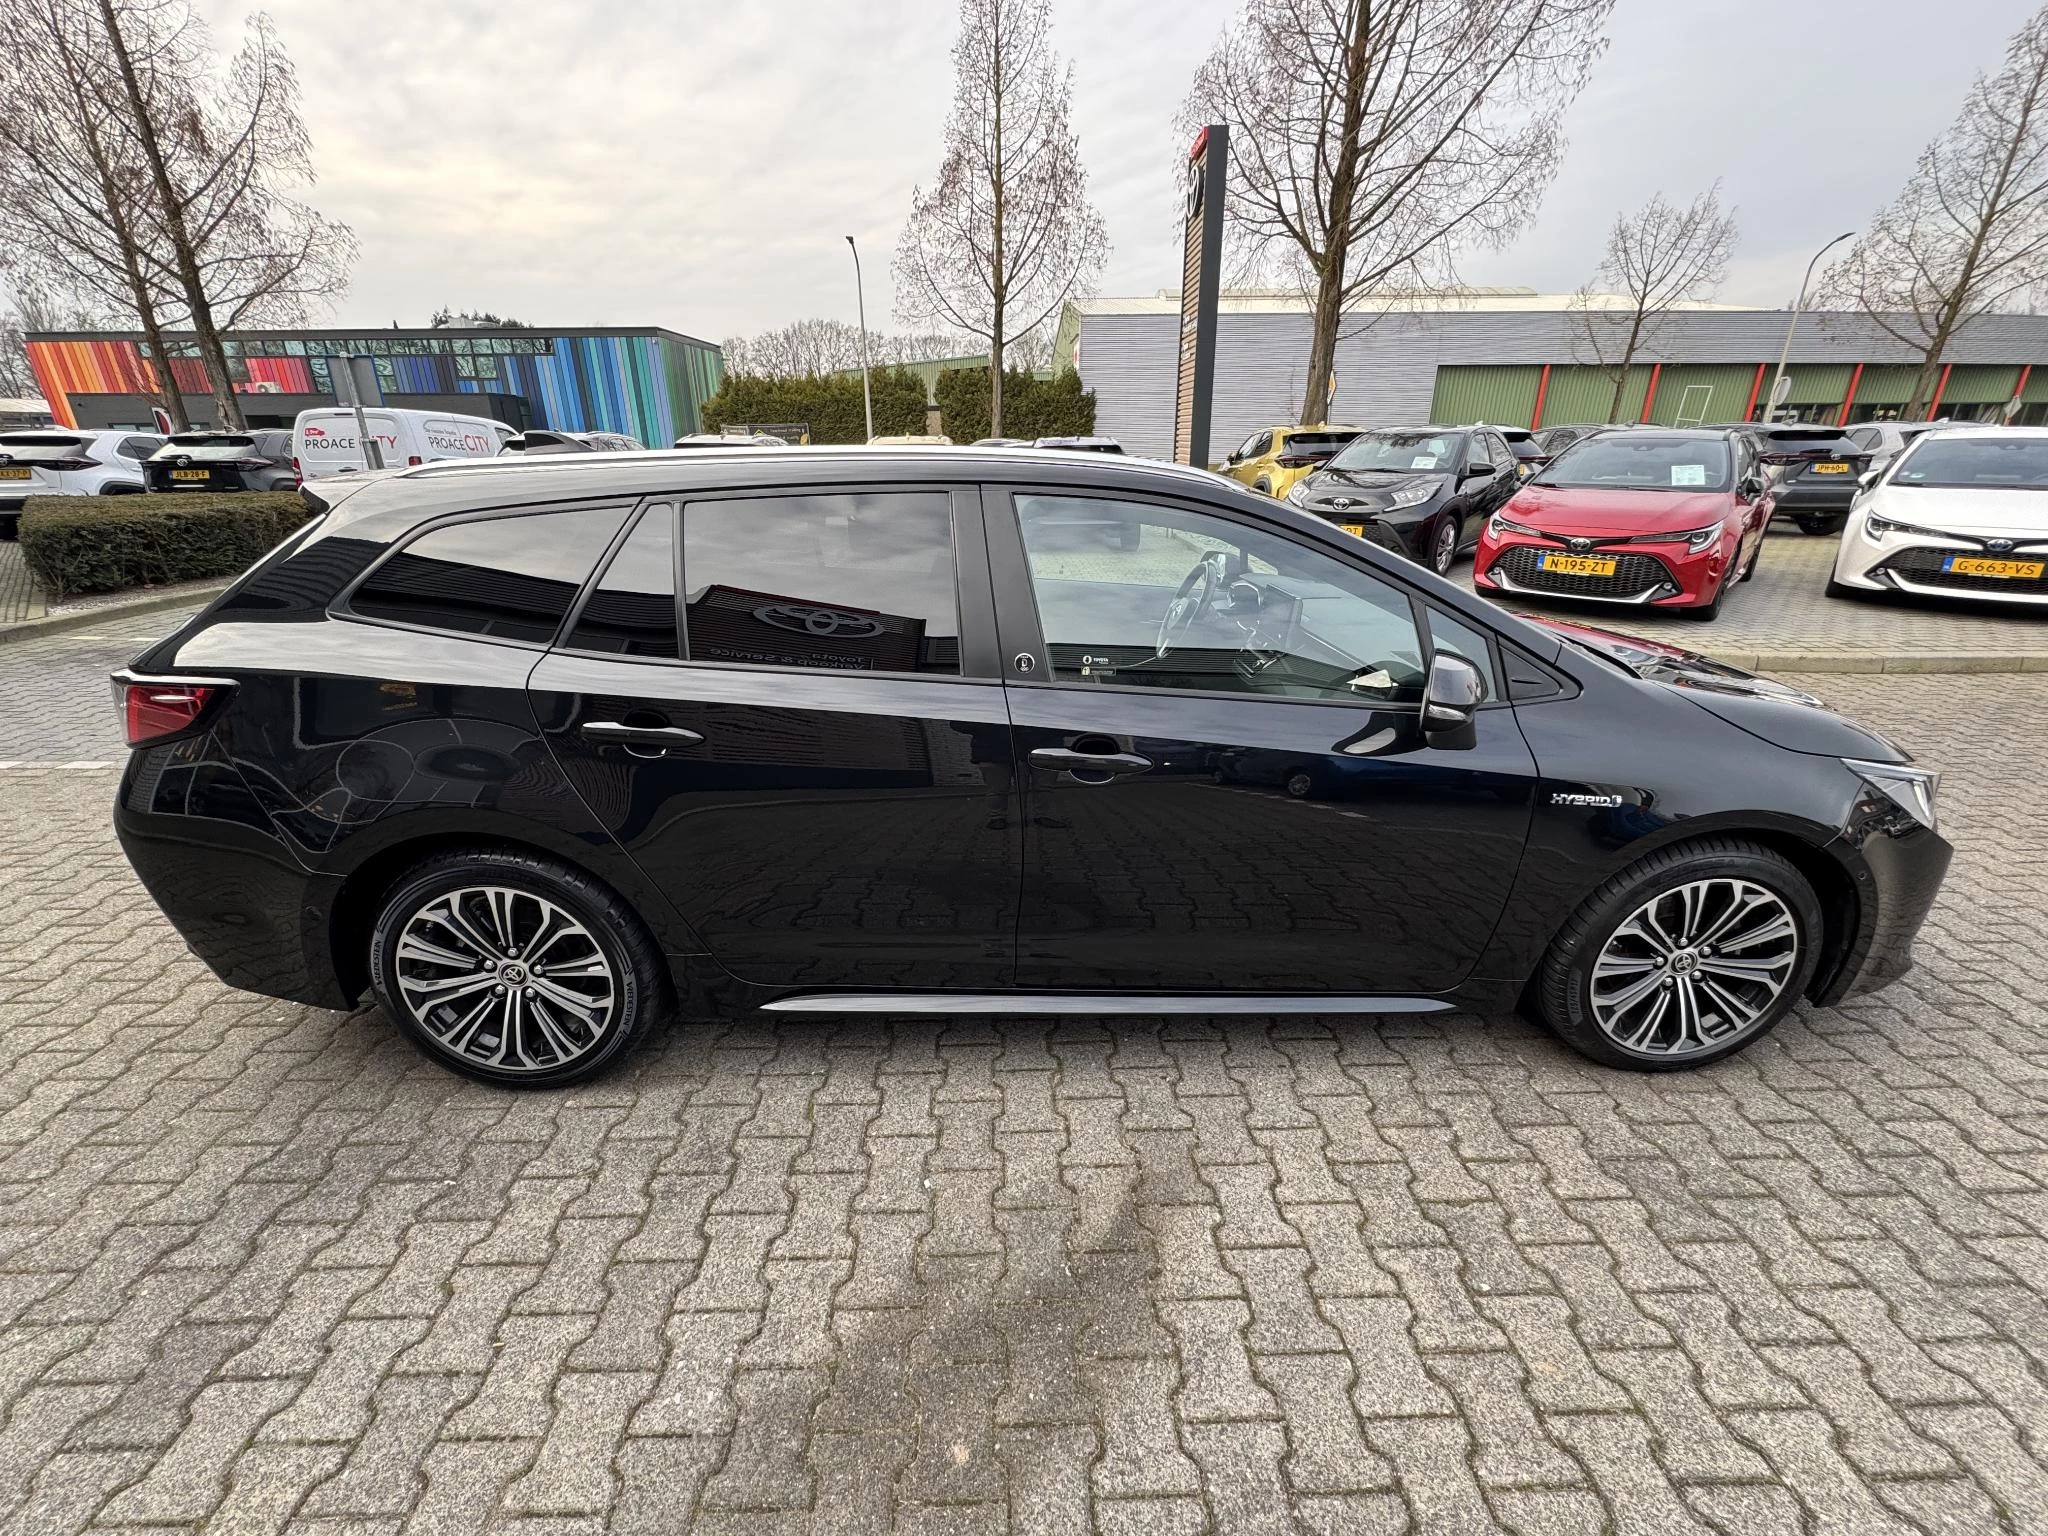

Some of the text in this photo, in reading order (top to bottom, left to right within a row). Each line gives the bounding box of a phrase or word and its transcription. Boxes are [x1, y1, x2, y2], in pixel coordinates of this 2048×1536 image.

[304, 435, 397, 449] PROACE TY
[428, 435, 491, 452] PROACE CITY
[1550, 558, 1609, 573] N-195-ZT
[1958, 560, 2036, 575] G-663-VS
[1550, 793, 1611, 807] HYBRID
